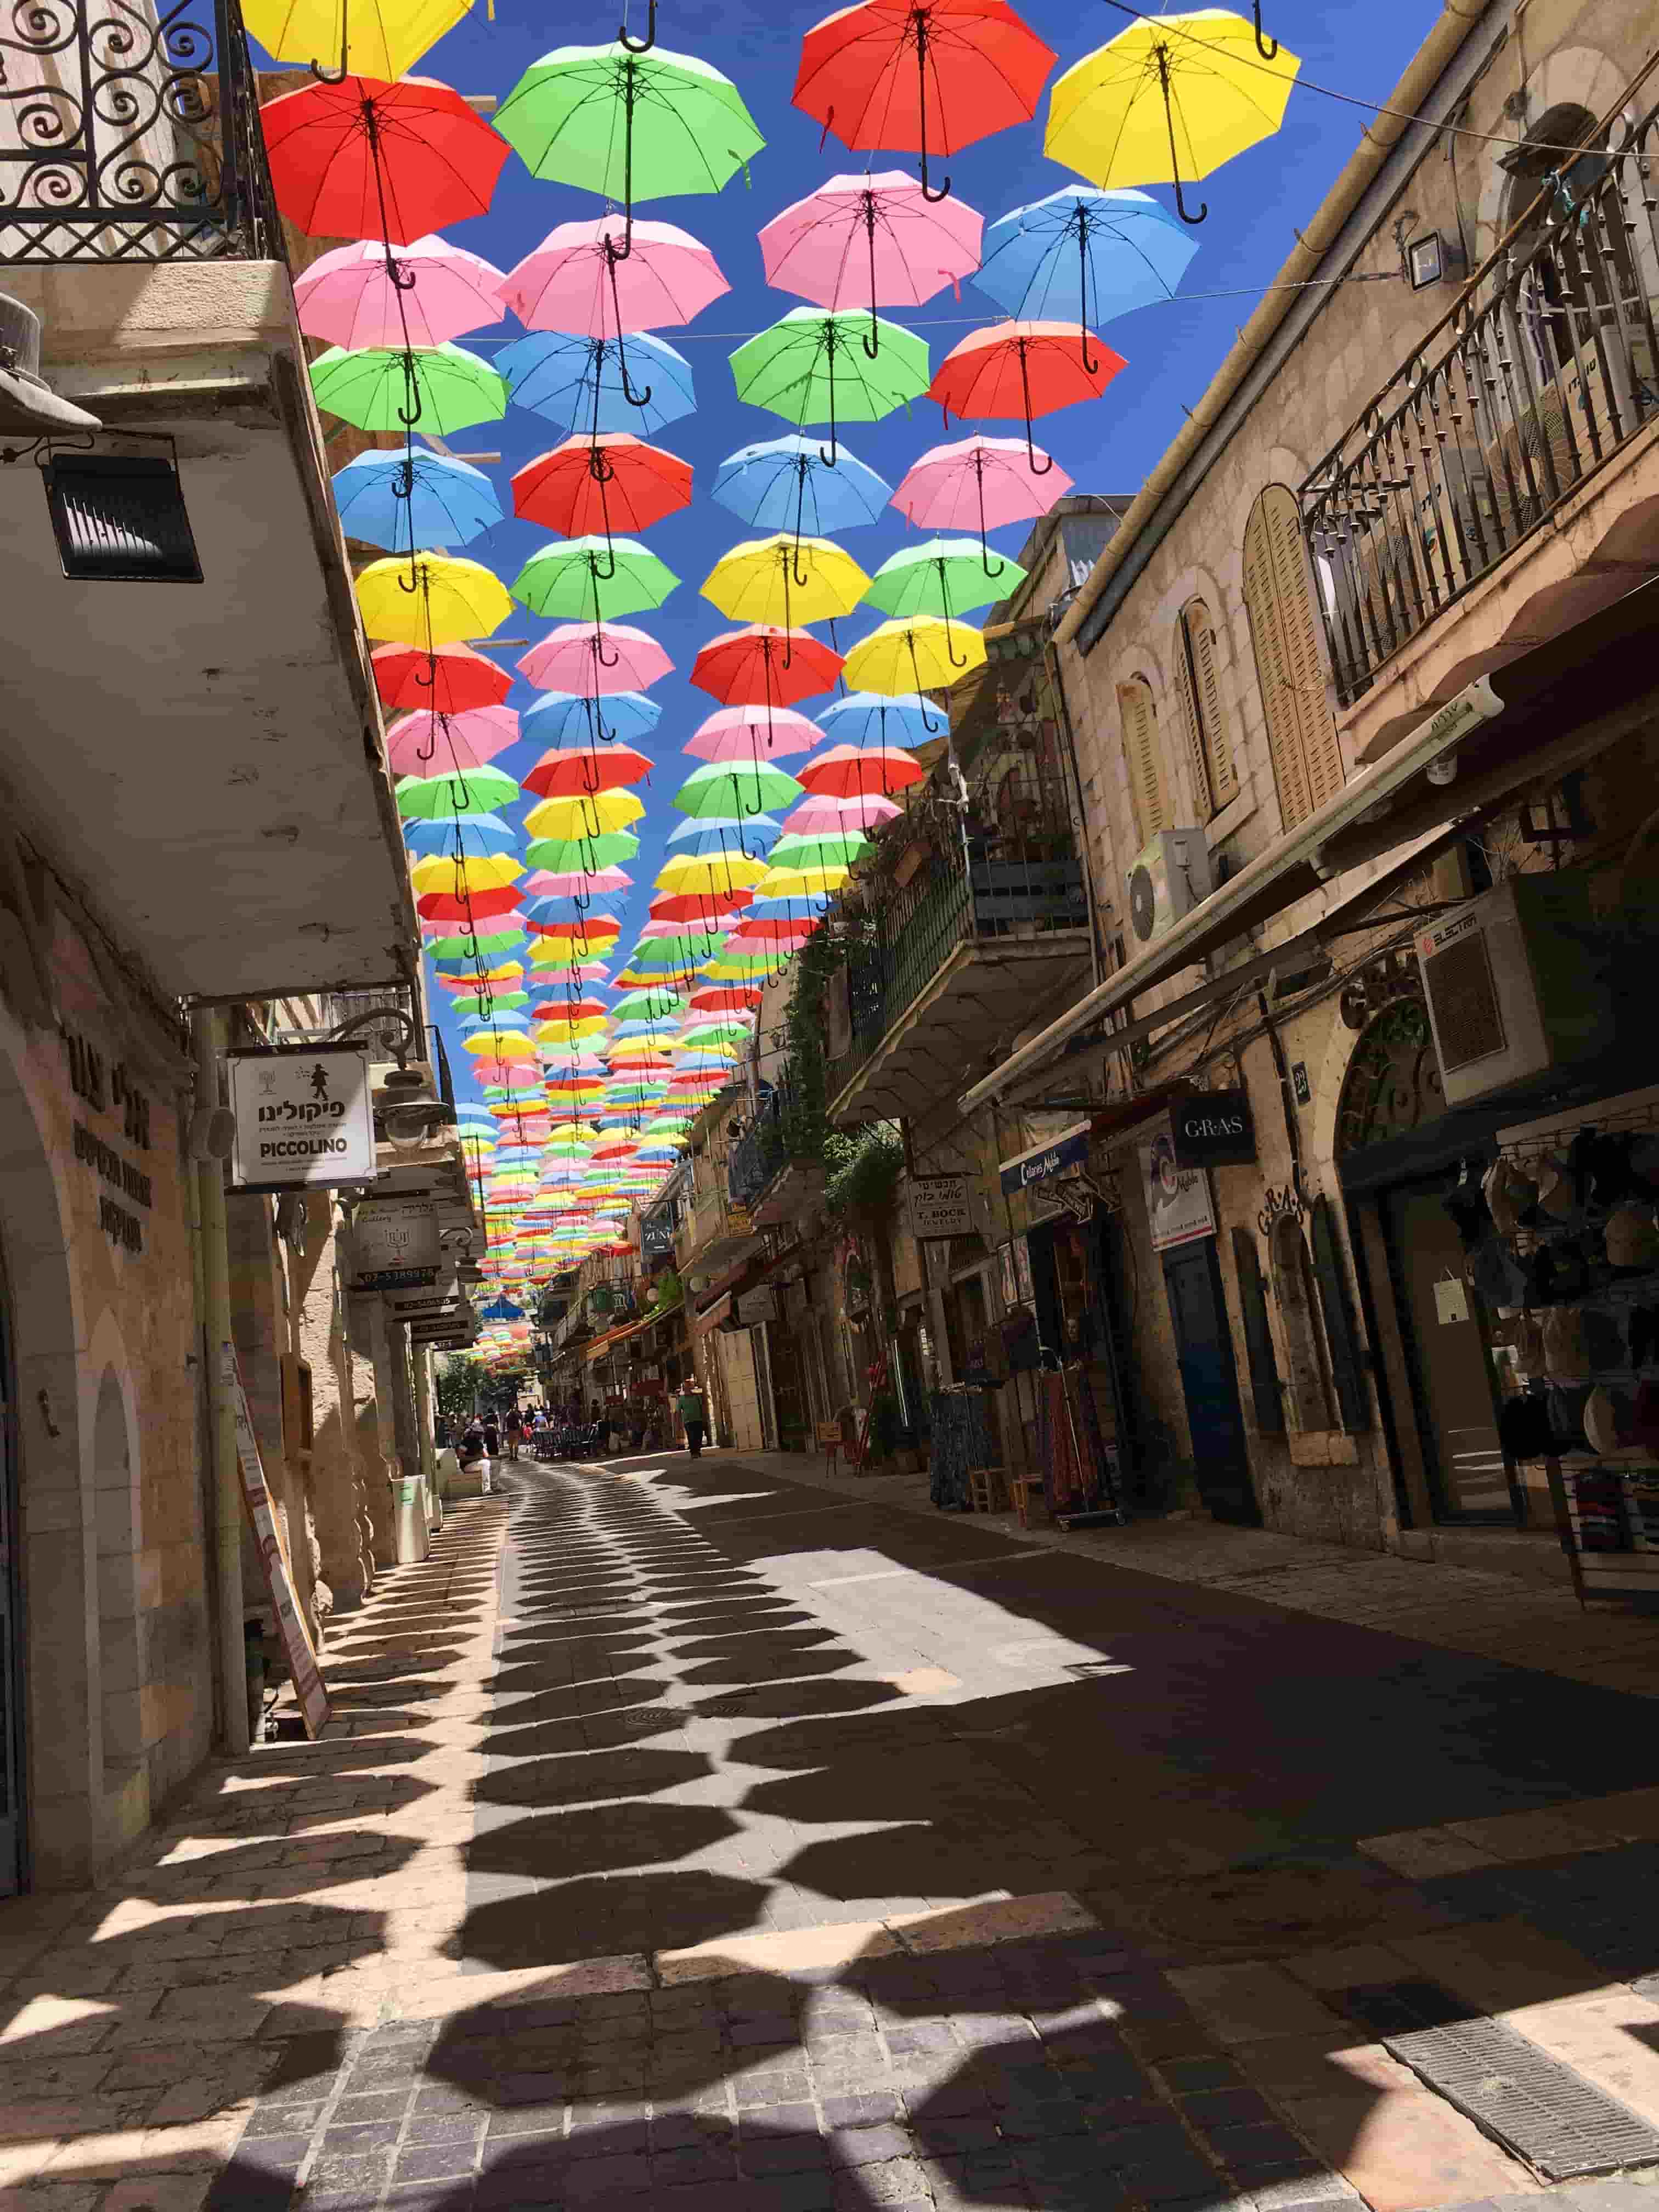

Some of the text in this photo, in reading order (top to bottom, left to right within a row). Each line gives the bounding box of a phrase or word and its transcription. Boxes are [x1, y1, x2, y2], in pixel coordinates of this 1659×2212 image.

[1433, 912, 1477, 946] ELECTRA
[1295, 1070, 1308, 1094] 23
[258, 1100, 345, 1122] פיקולינו
[259, 1138, 347, 1158] PICCOLINO
[918, 1180, 957, 1190] תכשיטי
[932, 1208, 966, 1218] BOCK
